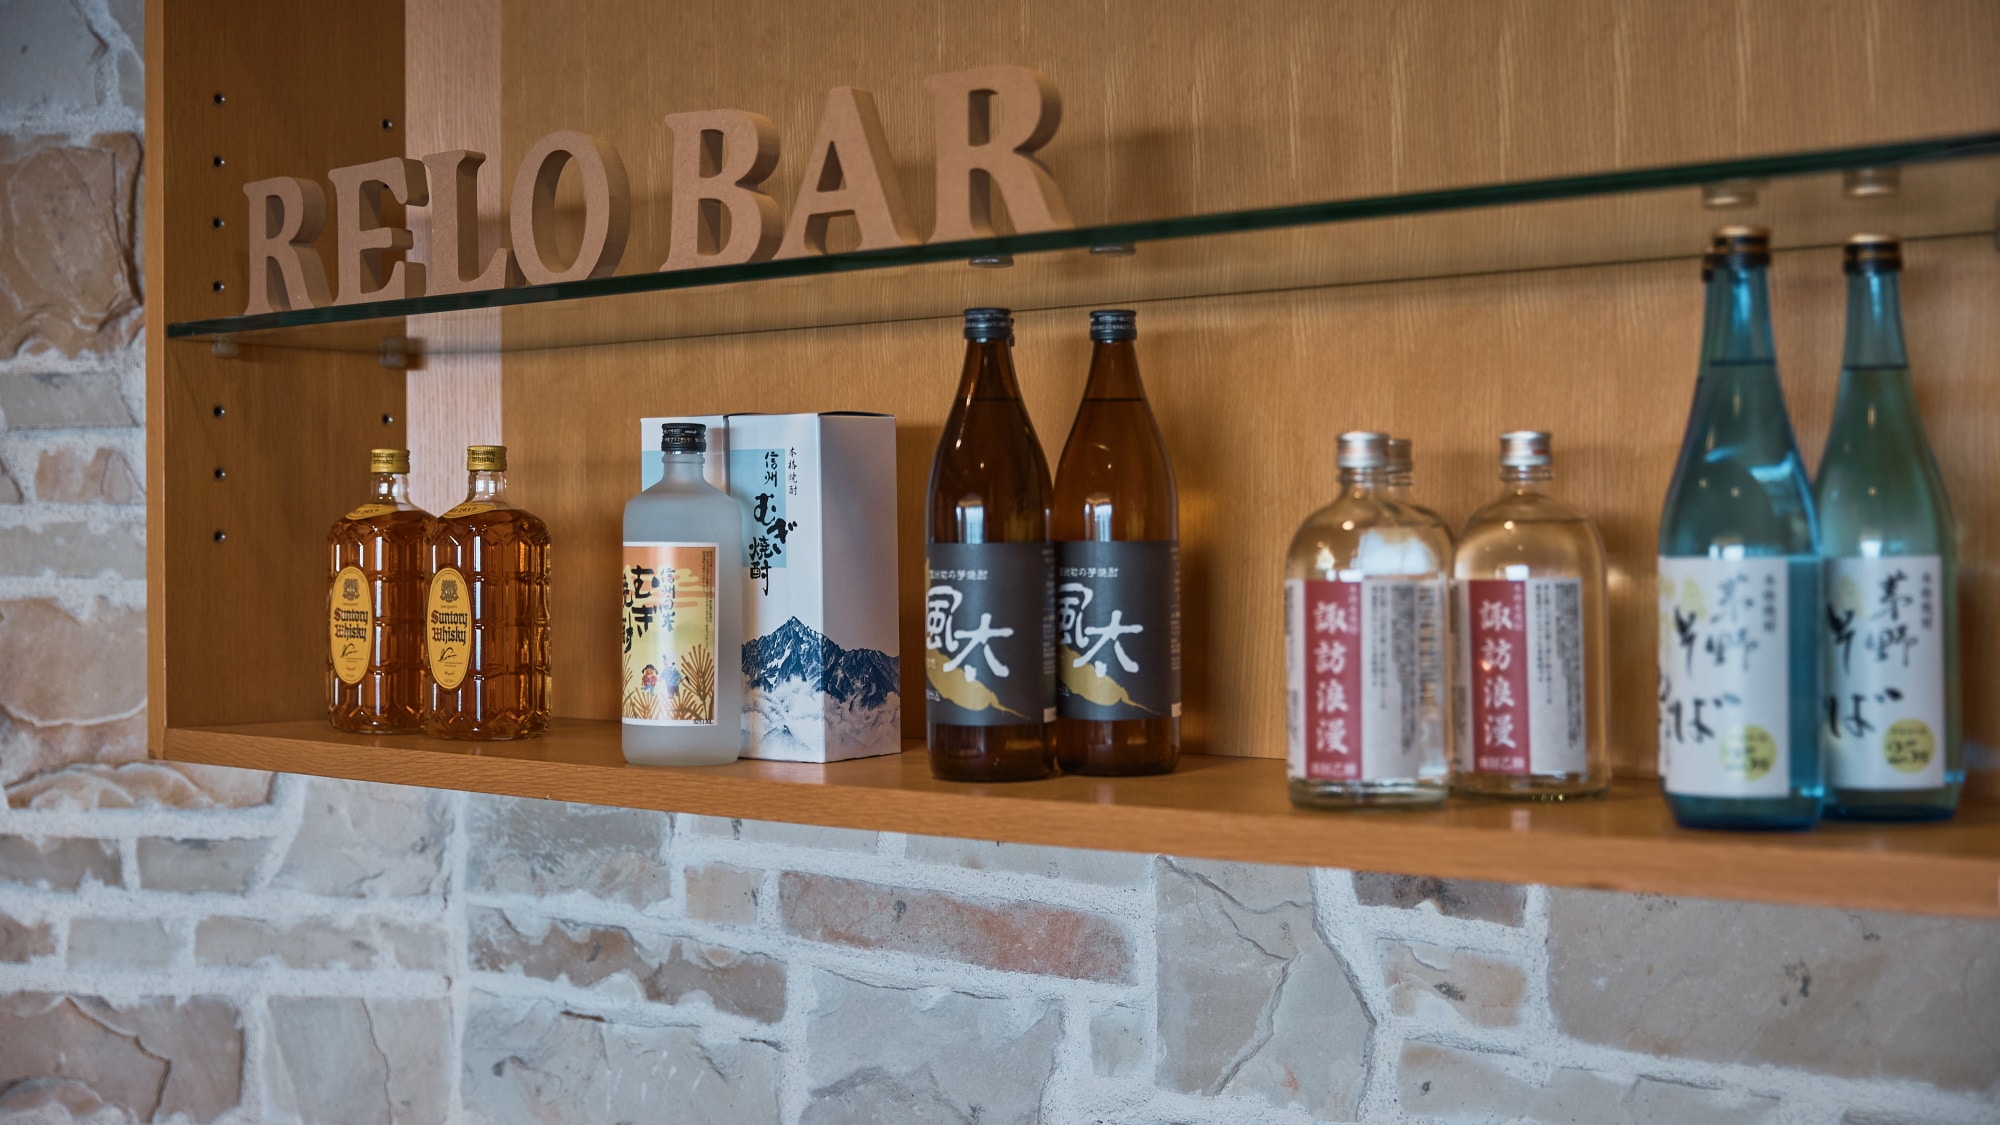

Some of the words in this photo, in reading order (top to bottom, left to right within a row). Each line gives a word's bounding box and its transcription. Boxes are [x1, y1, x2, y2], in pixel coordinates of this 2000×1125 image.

[243, 130, 627, 316] RELO
[658, 64, 1073, 273] BAR
[788, 447, 798, 496] 本格焼酎
[334, 608, 369, 625] Suntory
[431, 610, 468, 628] Suntory
[631, 564, 660, 637] むぎ
[335, 624, 367, 643] Whisky
[431, 627, 467, 646] Whisky
[926, 586, 1014, 682] 風太
[1313, 601, 1349, 754] 諏訪浪漫
[1479, 600, 1516, 748] 諏訪浪漫
